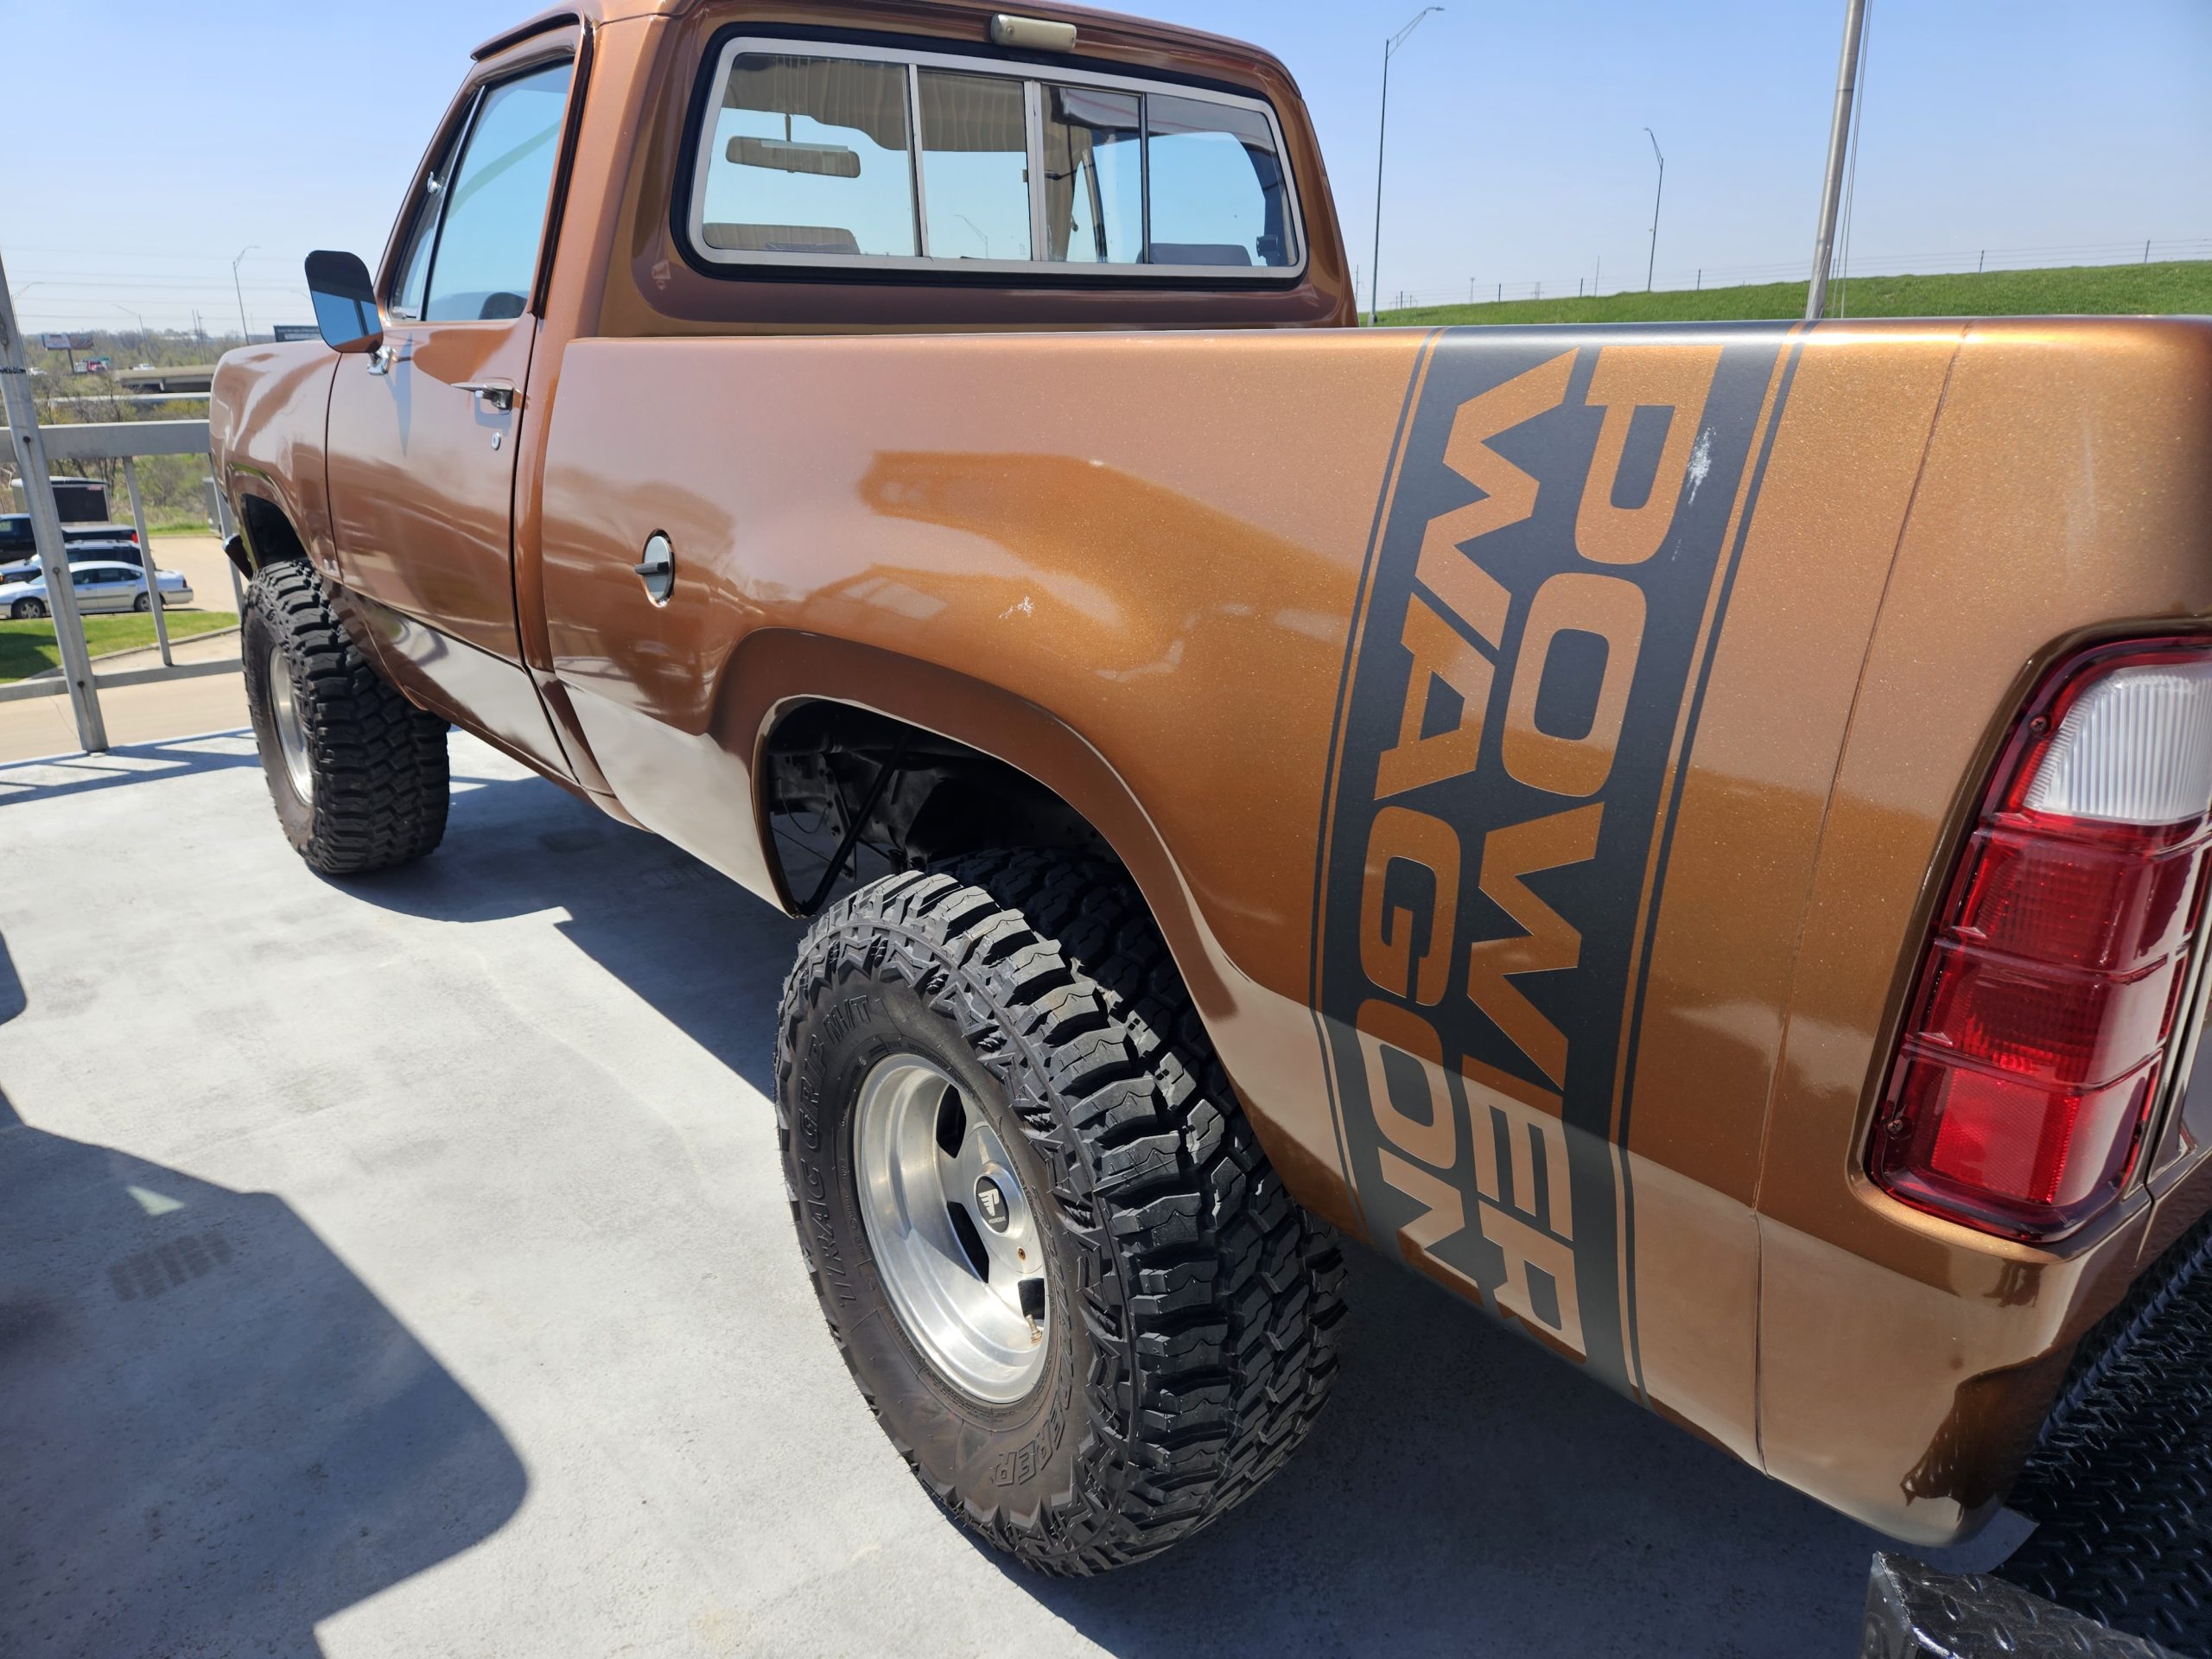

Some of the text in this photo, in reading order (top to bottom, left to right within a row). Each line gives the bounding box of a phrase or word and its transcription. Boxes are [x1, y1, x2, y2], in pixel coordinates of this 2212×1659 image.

[798, 1033, 827, 1149] GRIP
[1357, 346, 1580, 1307] WAGON
[1462, 346, 1724, 1363] POWER
